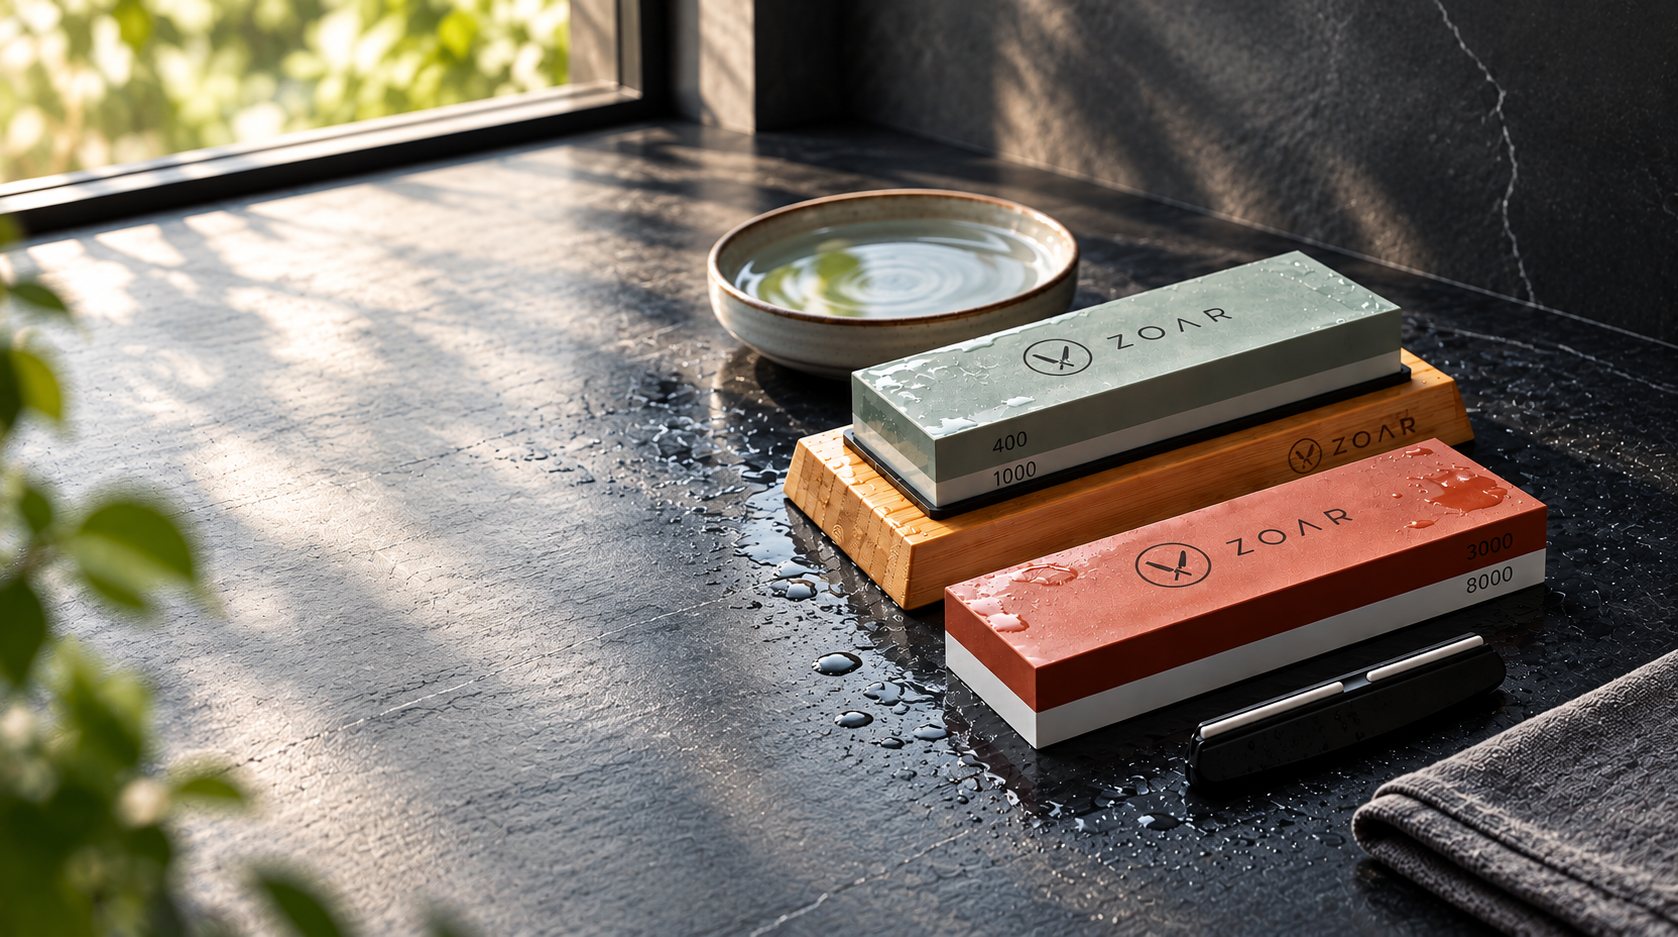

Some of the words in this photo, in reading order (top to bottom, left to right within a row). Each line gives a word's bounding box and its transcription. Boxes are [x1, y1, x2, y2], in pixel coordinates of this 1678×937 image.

[1106, 307, 1233, 351] ZOAR
[992, 431, 1028, 454] 400
[1332, 416, 1416, 456] ZOAR
[993, 461, 1037, 487] 1000
[1225, 507, 1353, 557] ZOAR
[1466, 532, 1514, 562] 3000
[1466, 566, 1514, 595] 8000
